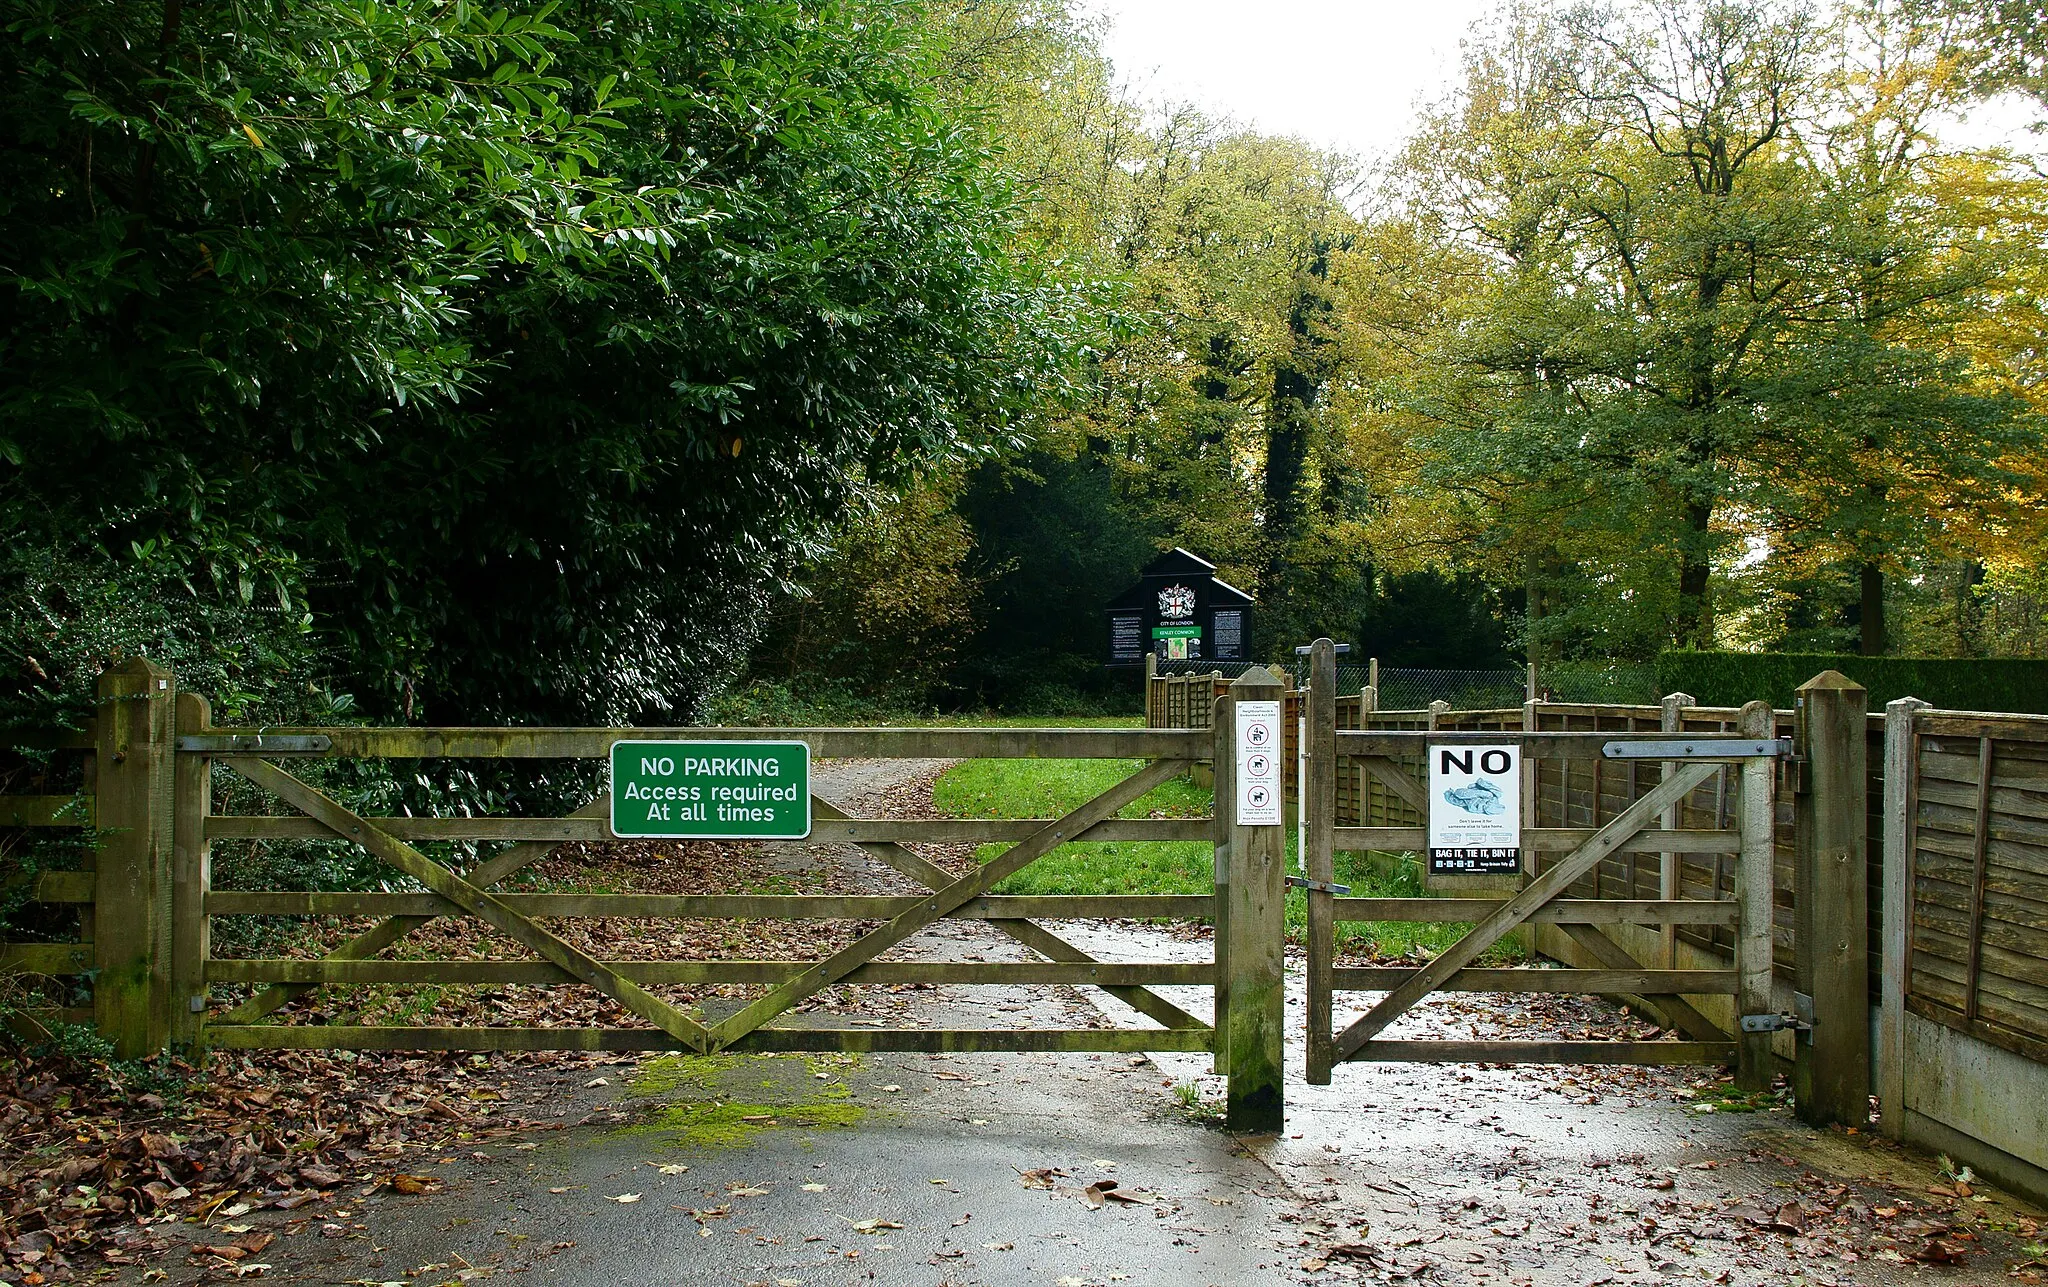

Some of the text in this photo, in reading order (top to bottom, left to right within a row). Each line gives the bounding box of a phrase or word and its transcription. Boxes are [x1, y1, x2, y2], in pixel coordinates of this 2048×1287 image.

[641, 757, 779, 777] NO PARKING
[1441, 750, 1511, 774] NO
[624, 782, 797, 804] Access required
[646, 803, 775, 822] At all times
[1435, 849, 1515, 859] BAG IT, TIE IT, BIN IT
